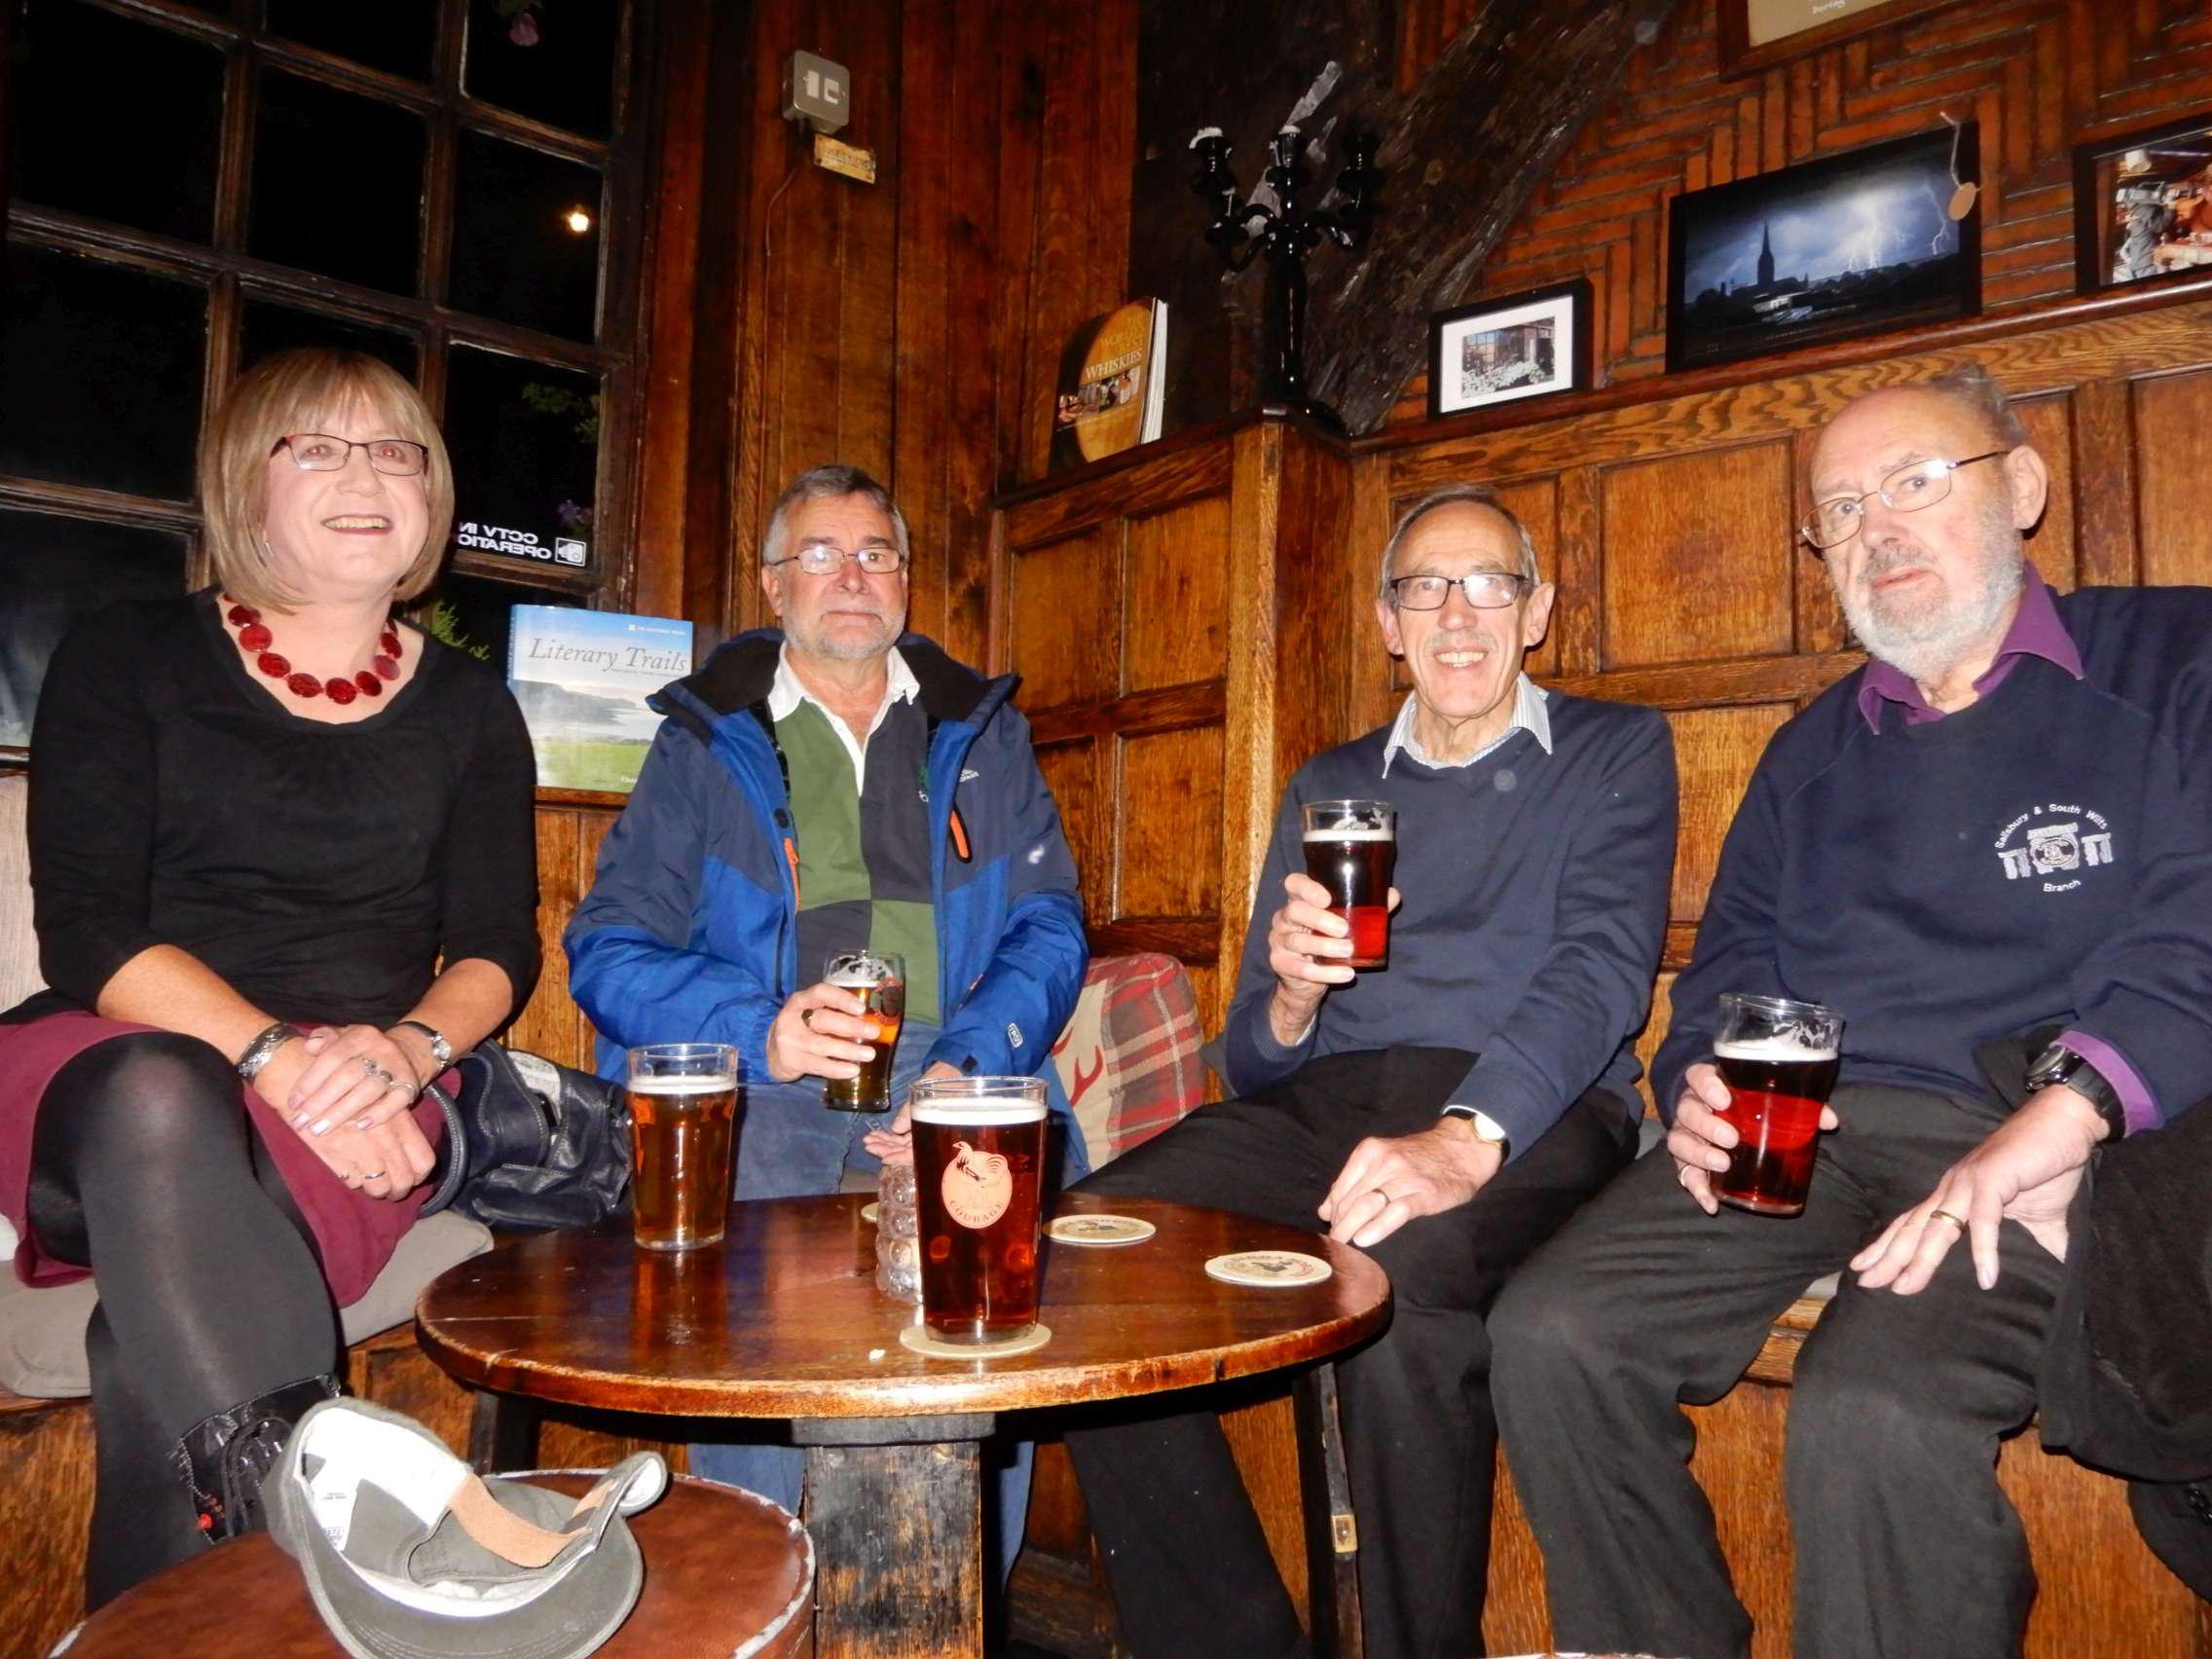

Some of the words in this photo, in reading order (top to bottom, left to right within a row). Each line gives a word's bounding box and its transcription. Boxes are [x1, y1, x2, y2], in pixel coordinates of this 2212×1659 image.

[1086, 348, 1142, 379] WHISKIES
[530, 638, 618, 672] Literary
[625, 646, 686, 672] Trails
[1994, 813, 2029, 849] Salisbury
[2033, 806, 2043, 815] &
[2048, 803, 2081, 815] South
[2043, 880, 2082, 893] Branch
[949, 1199, 1004, 1224] COURAGE
